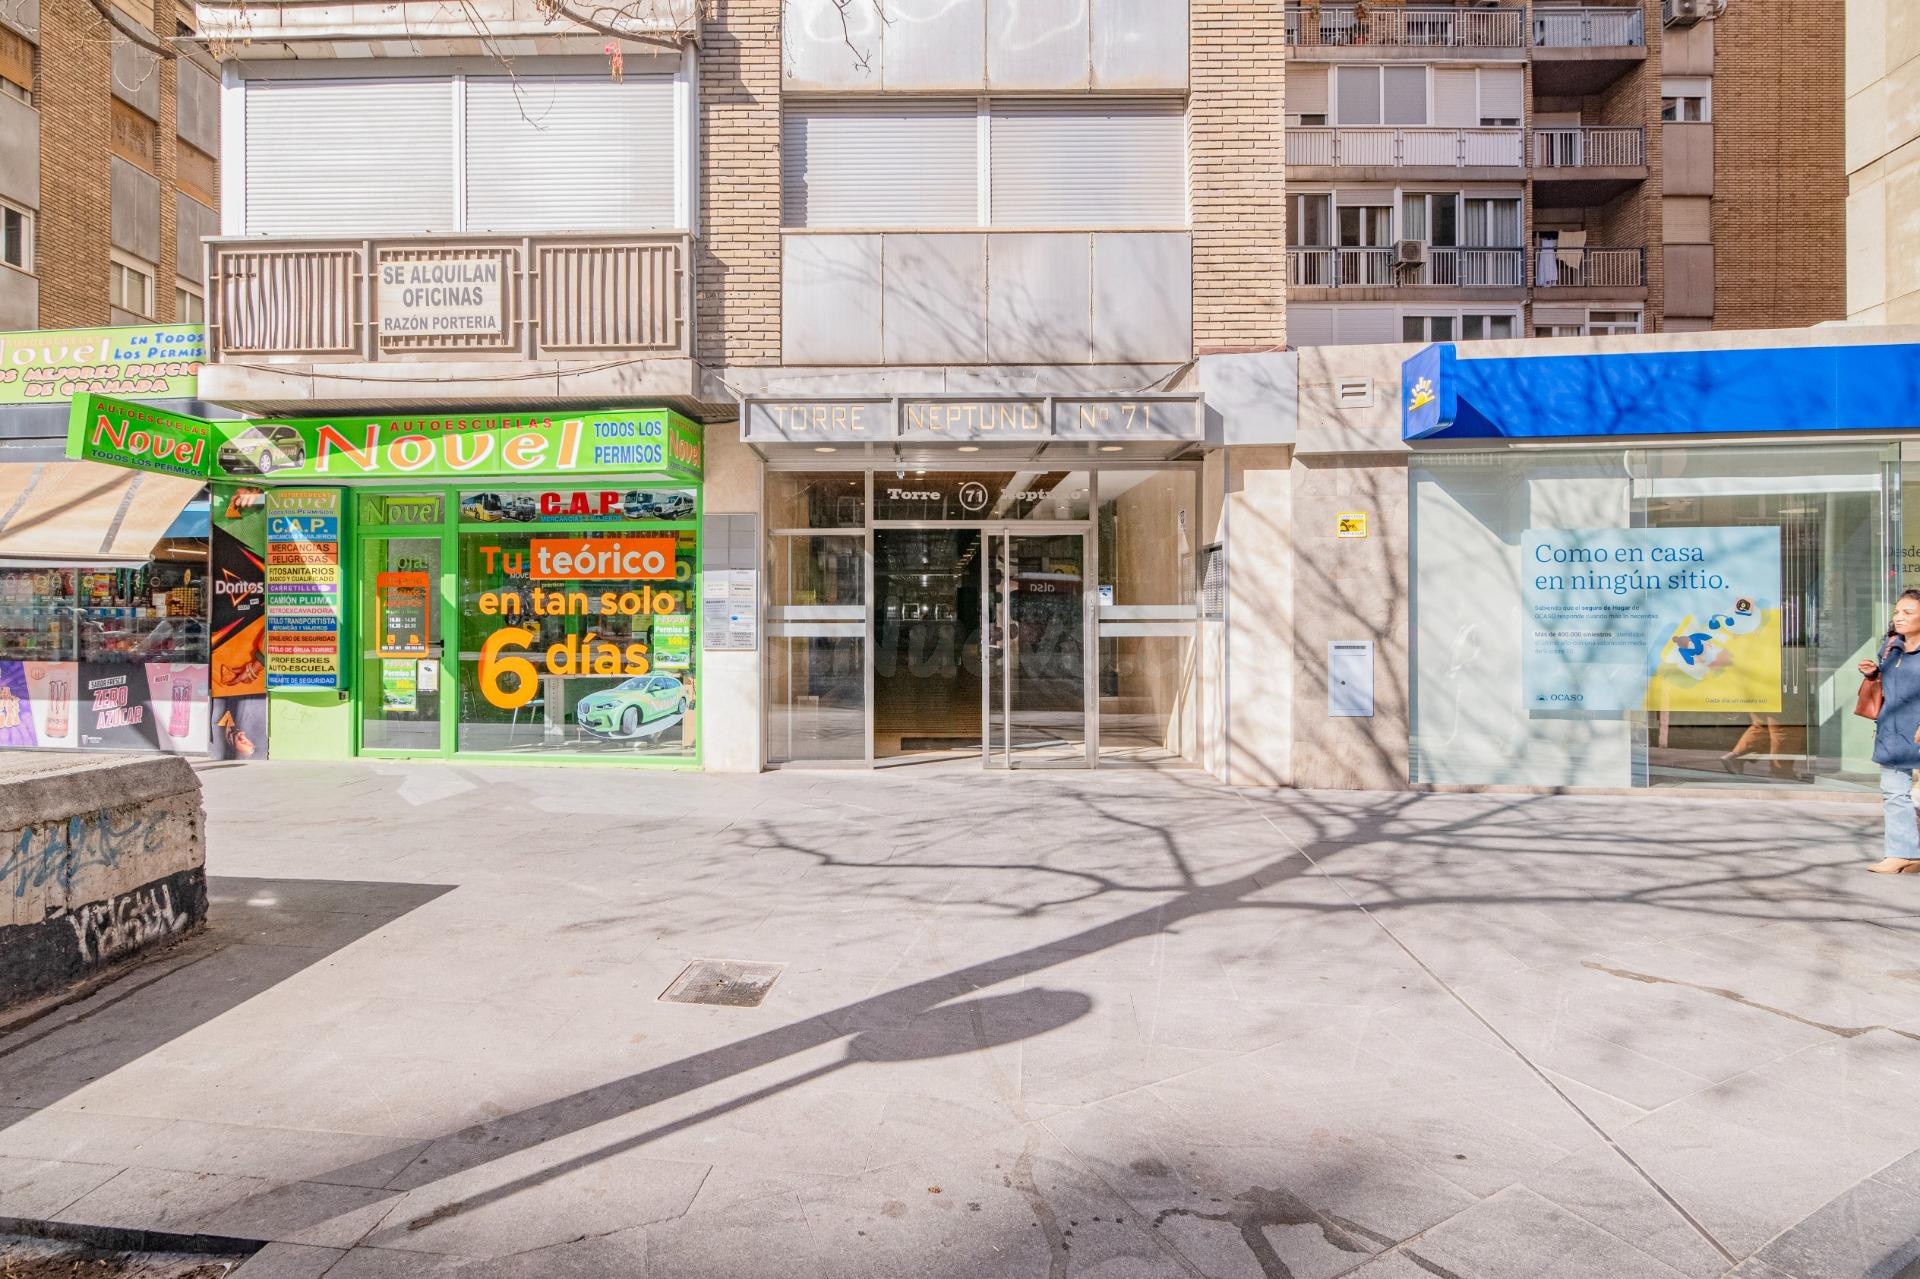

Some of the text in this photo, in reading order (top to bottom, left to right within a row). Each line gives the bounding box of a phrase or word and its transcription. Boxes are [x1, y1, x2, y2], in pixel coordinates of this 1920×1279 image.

[384, 264, 496, 284] SE ALQUILAN
[403, 287, 483, 307] OFICINAS
[385, 315, 496, 330] RAZÓN PORTERIA
[0, 338, 111, 366] ovel
[114, 346, 206, 360] LOS PERMIS
[124, 361, 205, 378] PRECIO
[97, 402, 207, 436] AUTOESCUELAS
[390, 418, 552, 432] AUTOESCUELAS
[774, 406, 866, 431] TORRE
[907, 404, 1040, 431] NEPTUNO
[1120, 405, 1152, 430] 71
[92, 414, 206, 466] Novel
[594, 422, 635, 438] TODOS
[638, 420, 663, 437] LOS
[315, 420, 583, 472] Novel
[594, 444, 663, 465] PERMISOS
[92, 449, 203, 477] TODOS LOS PERMISOS
[540, 491, 621, 515] C.A.P.
[887, 488, 941, 501] Torre
[964, 490, 984, 503] 71
[367, 496, 440, 522] Novel
[272, 518, 329, 533] C.A.P.
[272, 555, 328, 564] PELIGROSAS
[480, 543, 665, 575] Tu teórico
[1535, 544, 1704, 563] Como en casa
[269, 567, 335, 576] FITOSANITARIOS
[1535, 569, 1730, 595] en ningún sitio.
[215, 580, 264, 595] Doritos
[479, 592, 520, 615] en
[533, 587, 588, 615] tan
[601, 585, 676, 615] solo
[545, 632, 649, 675] días
[478, 627, 538, 710] 6
[92, 686, 128, 711] ZERO
[1551, 693, 1584, 702] OCASO
[96, 705, 143, 729] AZÚCAR
